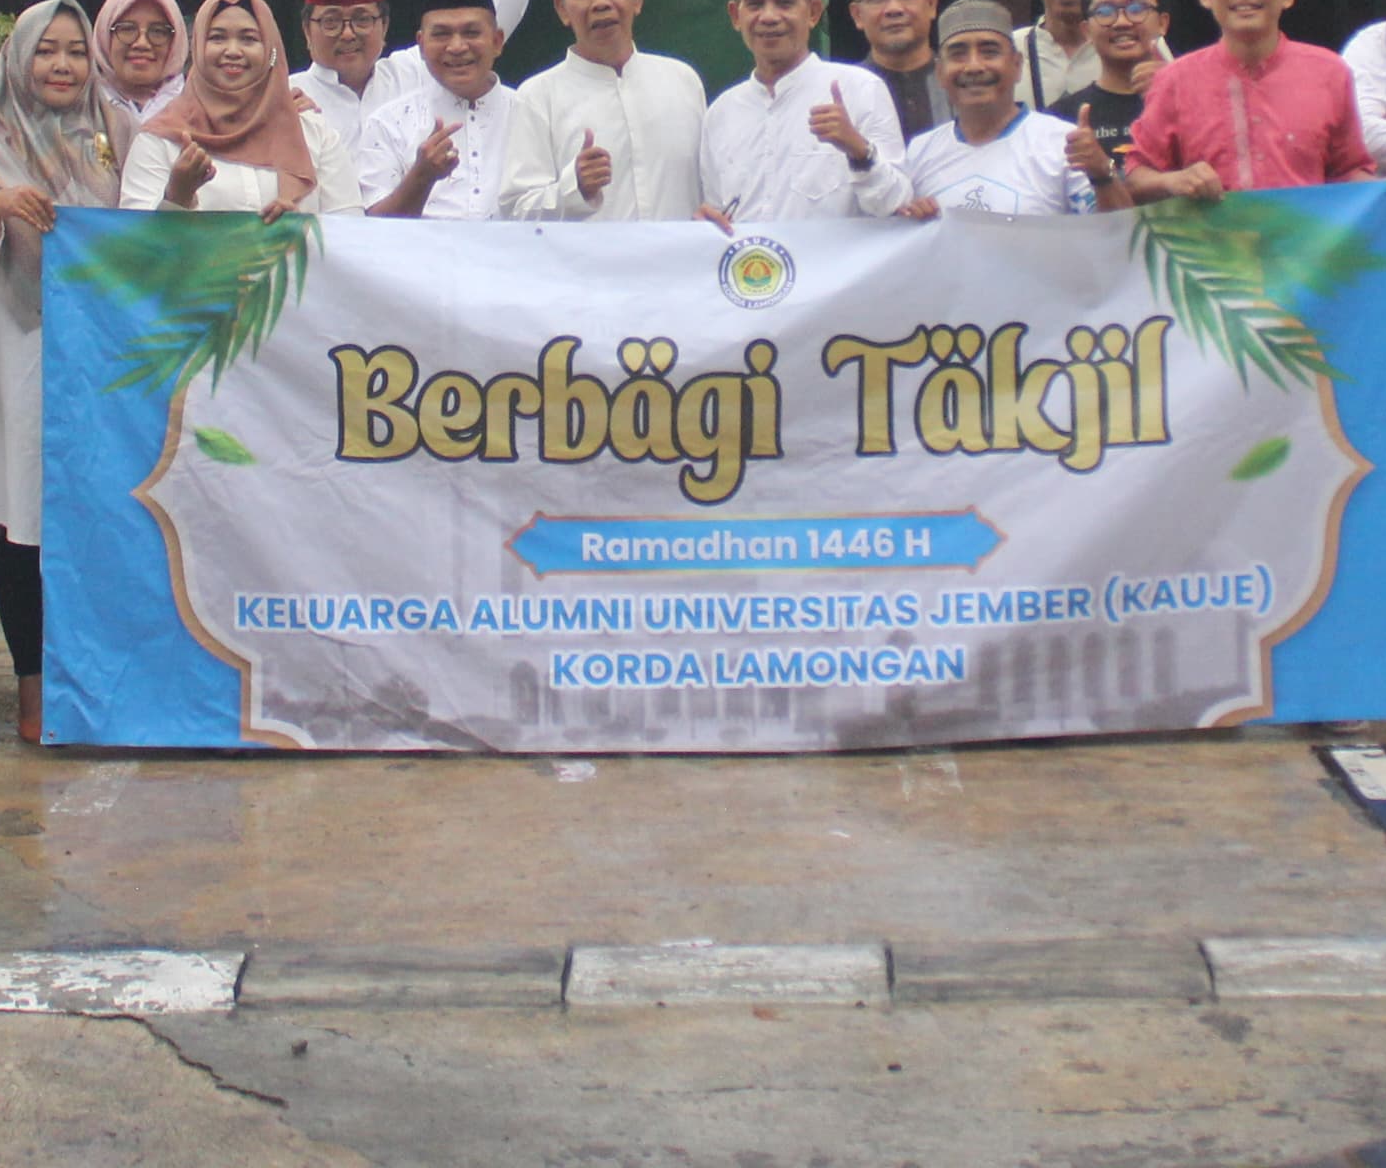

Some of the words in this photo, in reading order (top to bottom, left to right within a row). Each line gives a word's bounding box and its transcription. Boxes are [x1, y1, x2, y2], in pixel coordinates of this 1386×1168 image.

[1095, 126, 1119, 139] the
[581, 529, 797, 562] Ramadhan
[806, 529, 896, 560] 1446
[905, 528, 932, 558] H
[236, 594, 459, 631] KELUARGA
[470, 596, 632, 631] ALUMNI
[644, 594, 918, 631] UNIVERSITAS
[929, 587, 1093, 627] JEMBER
[1104, 564, 1273, 623] (KAUJE)
[552, 652, 704, 687] KORDA
[714, 647, 966, 686] LAMONGAN
